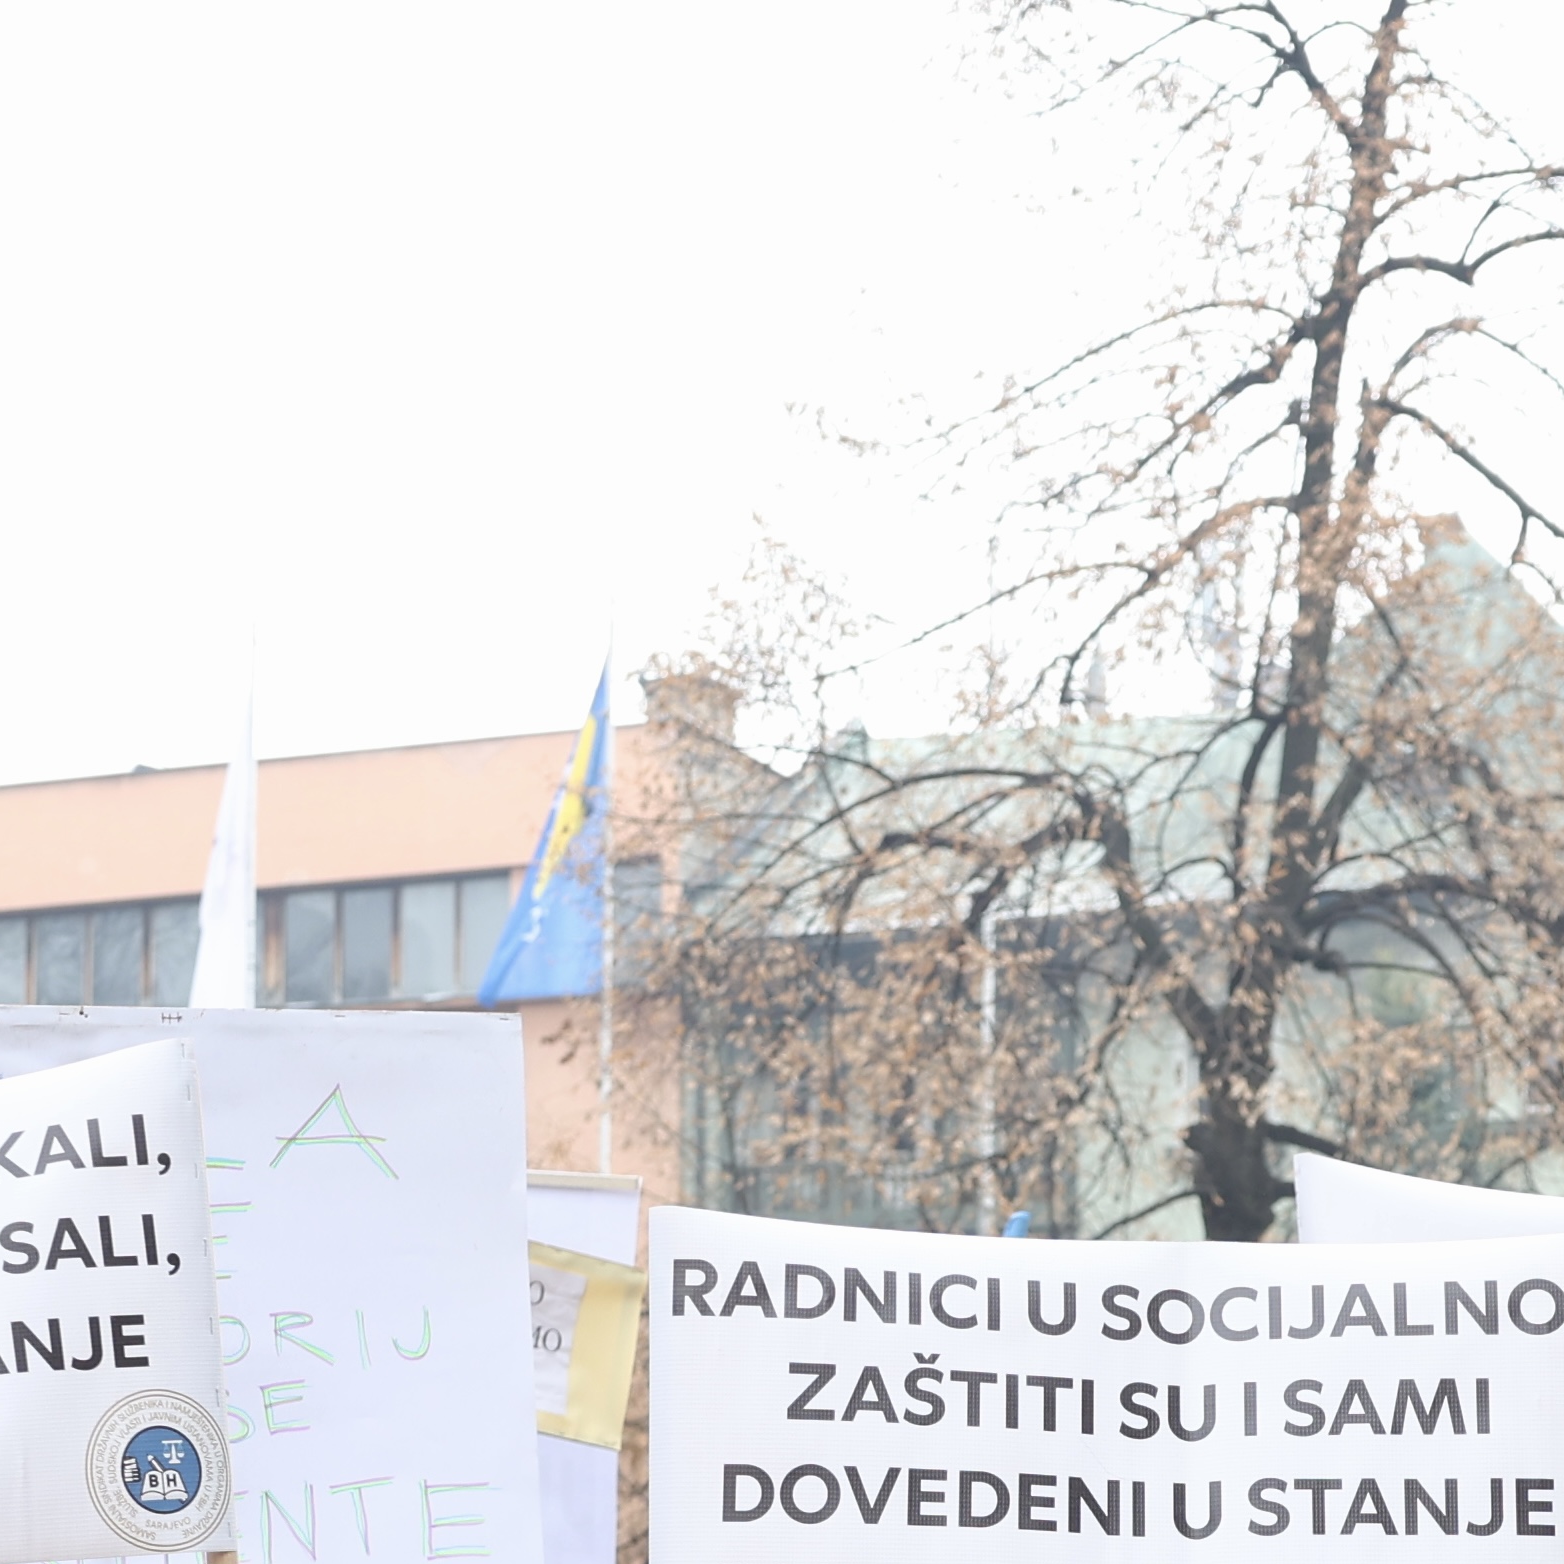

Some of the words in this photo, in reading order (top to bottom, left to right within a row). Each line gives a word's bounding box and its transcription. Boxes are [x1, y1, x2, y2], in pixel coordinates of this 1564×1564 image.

[672, 1259, 1000, 1331] RADNICI
[1028, 1280, 1076, 1336] U
[118, 1400, 164, 1423] SLUŽBENIKA
[148, 1412, 182, 1426] JAVNIM
[787, 1352, 1094, 1435] ZAŠTITI
[1119, 1382, 1216, 1442] SU
[1244, 1382, 1257, 1436] I
[1284, 1378, 1490, 1437] SAMI
[145, 1517, 191, 1530] SARAJEVO
[722, 1464, 1145, 1537] DOVEDENI
[1173, 1481, 1222, 1540] U
[1248, 1478, 1555, 1536] STANJE
